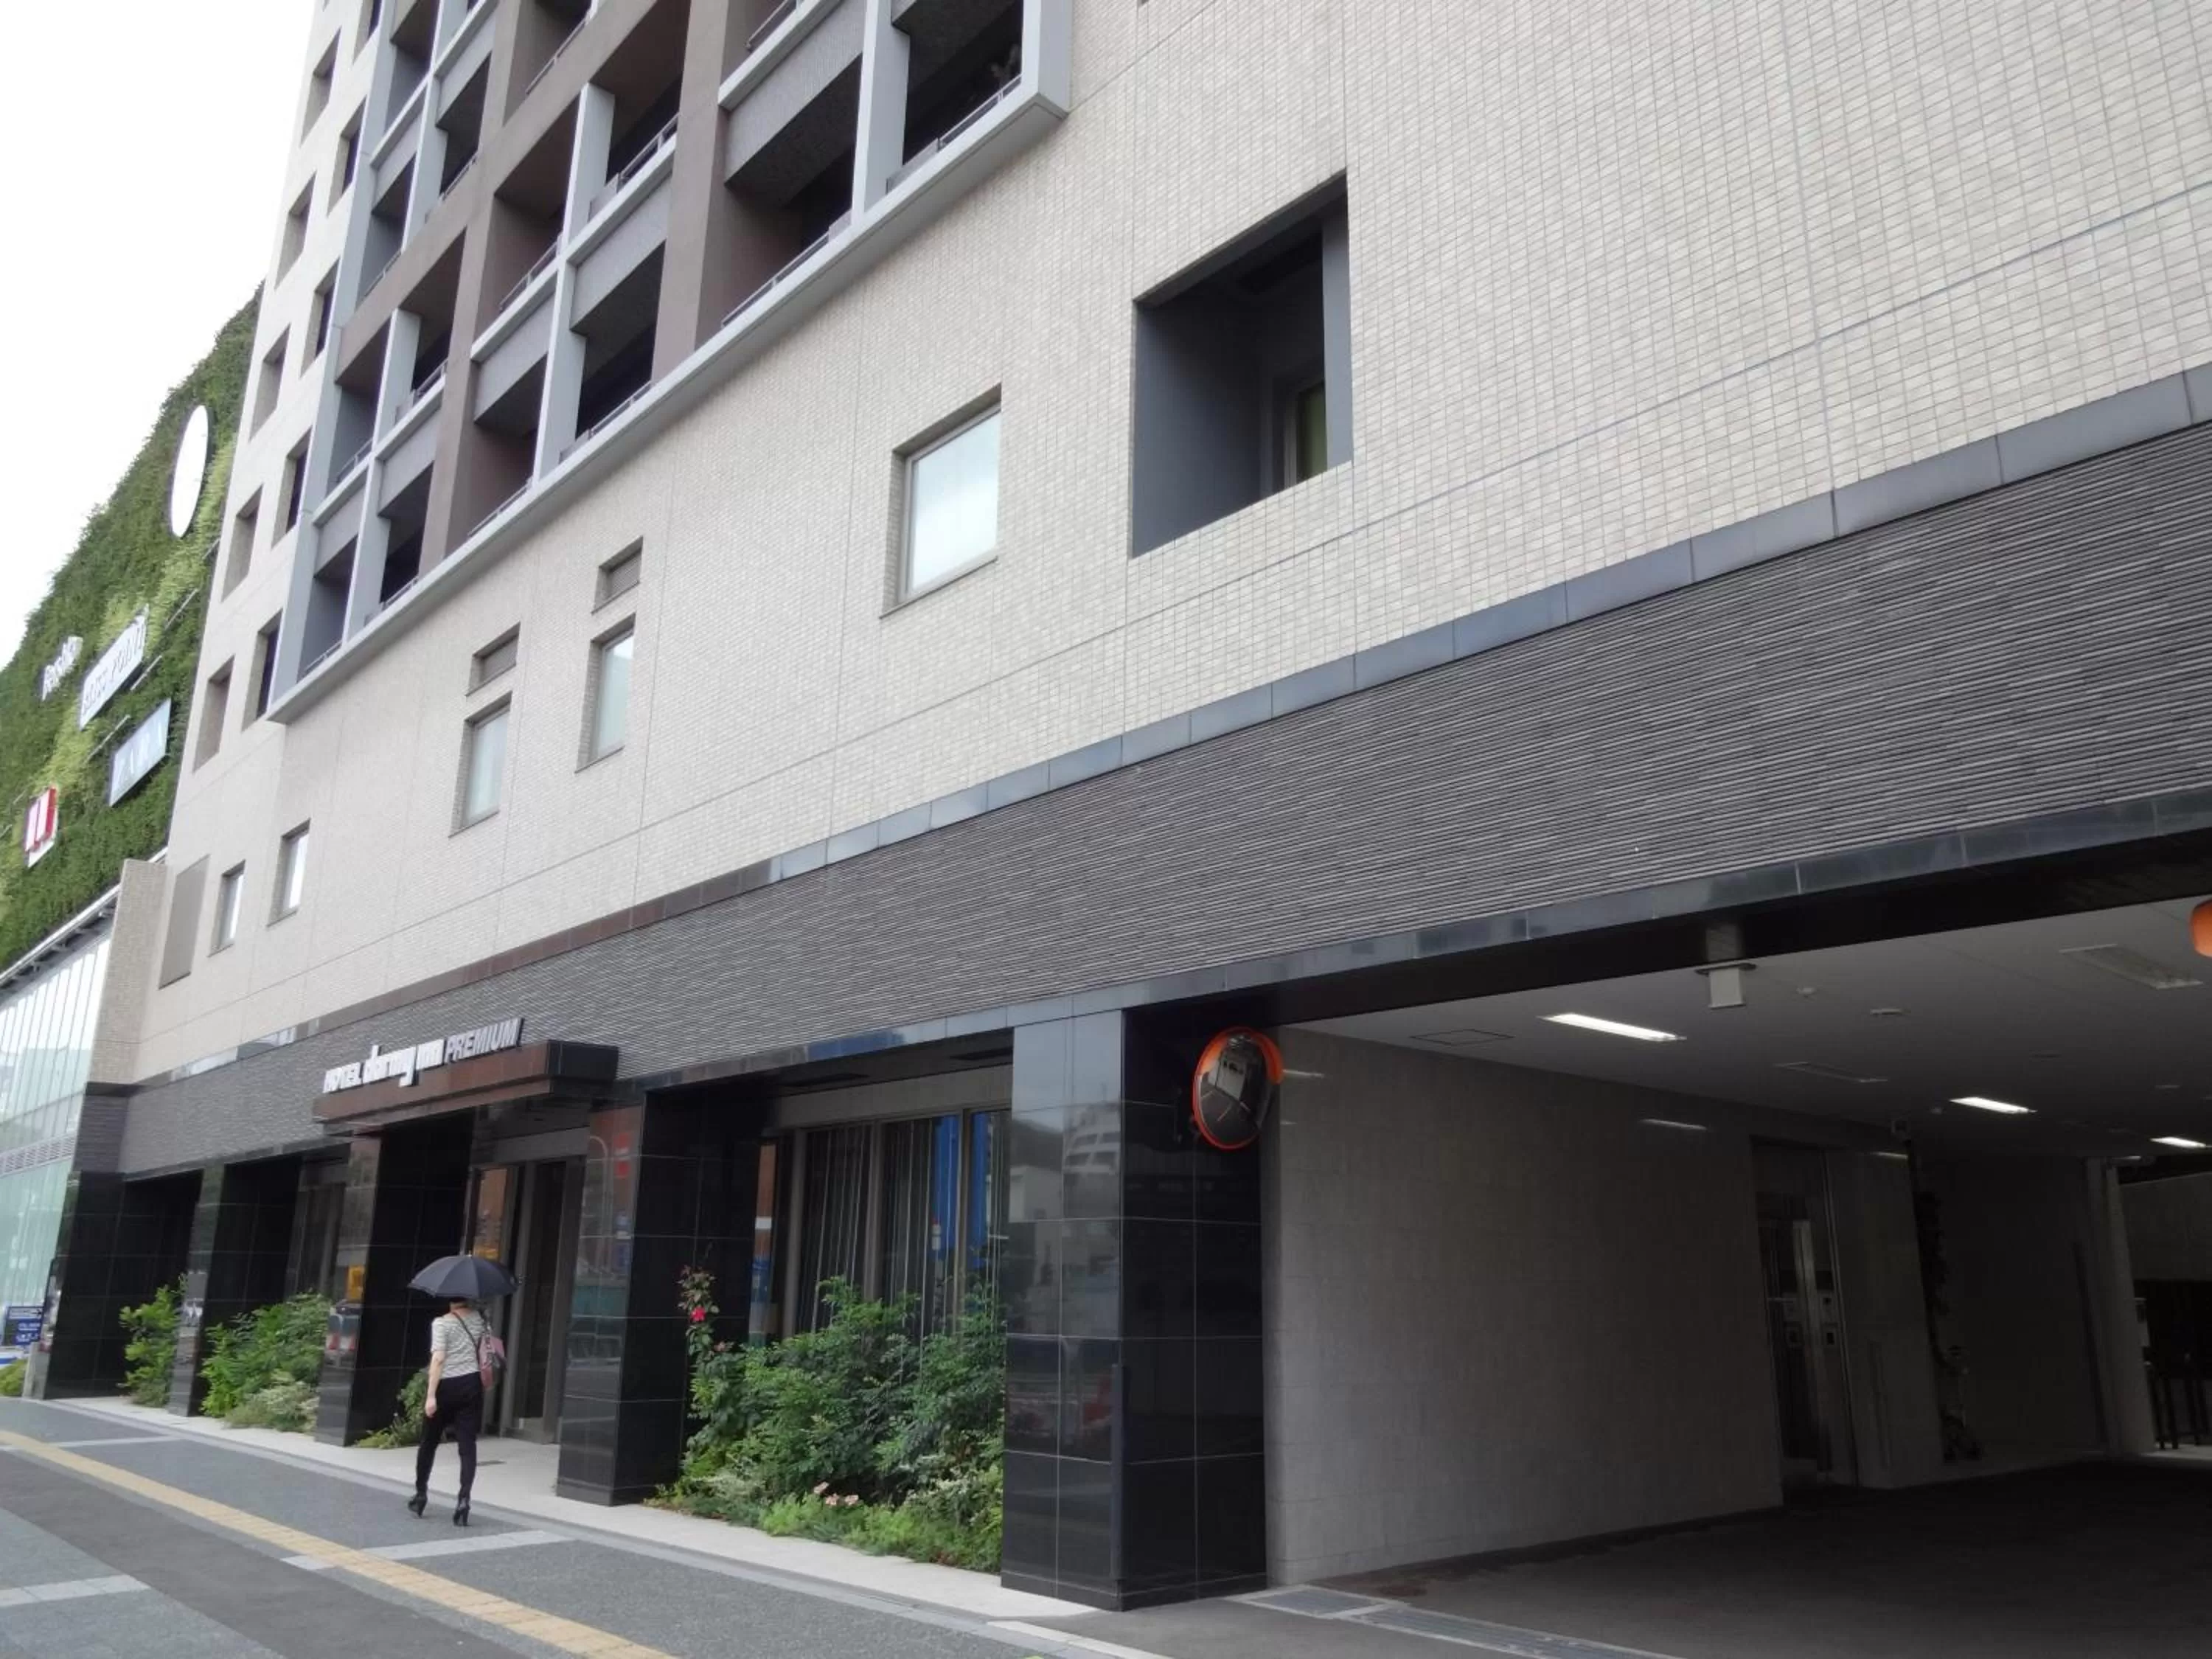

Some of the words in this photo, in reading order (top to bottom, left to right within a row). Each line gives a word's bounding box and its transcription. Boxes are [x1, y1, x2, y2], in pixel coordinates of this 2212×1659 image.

[322, 1062, 363, 1094] HOTEL
[362, 1044, 417, 1088] dormy
[443, 1017, 523, 1065] PREMIUM
